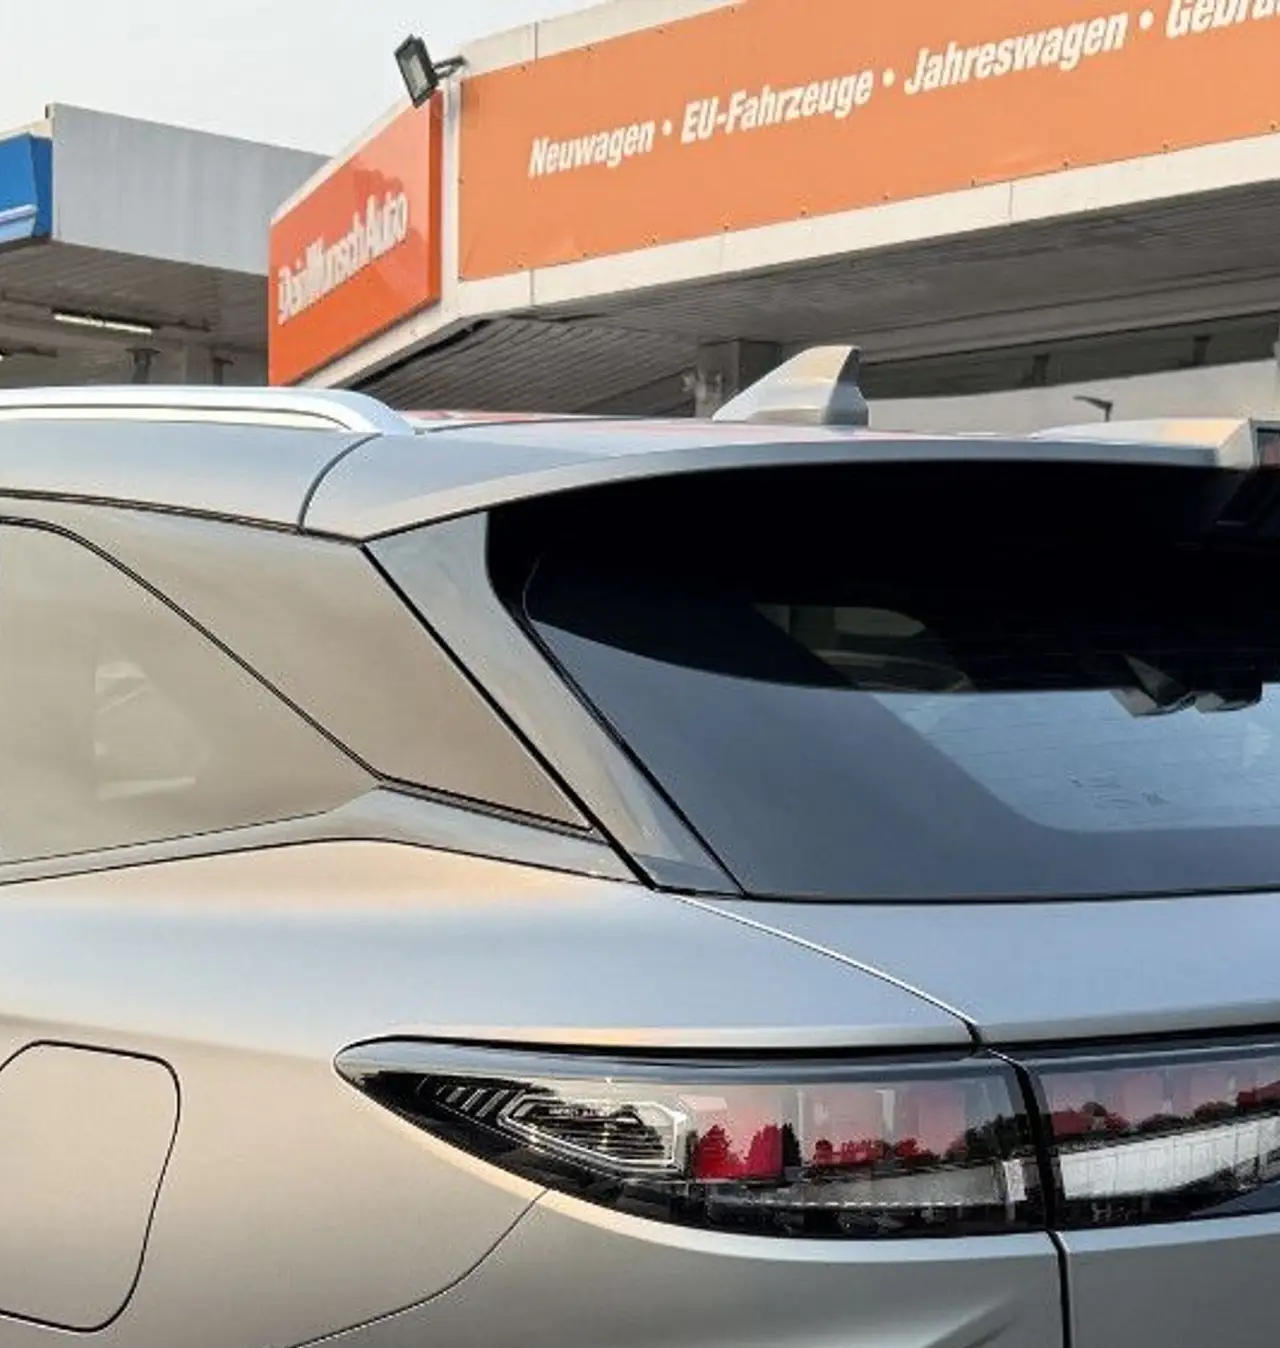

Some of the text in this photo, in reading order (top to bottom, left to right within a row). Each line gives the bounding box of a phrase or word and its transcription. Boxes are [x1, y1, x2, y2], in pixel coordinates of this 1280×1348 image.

[528, 118, 656, 178] Neuwagen
[680, 68, 874, 143] EU-Fahrzeuge
[904, 11, 1128, 95] Jahreswagen
